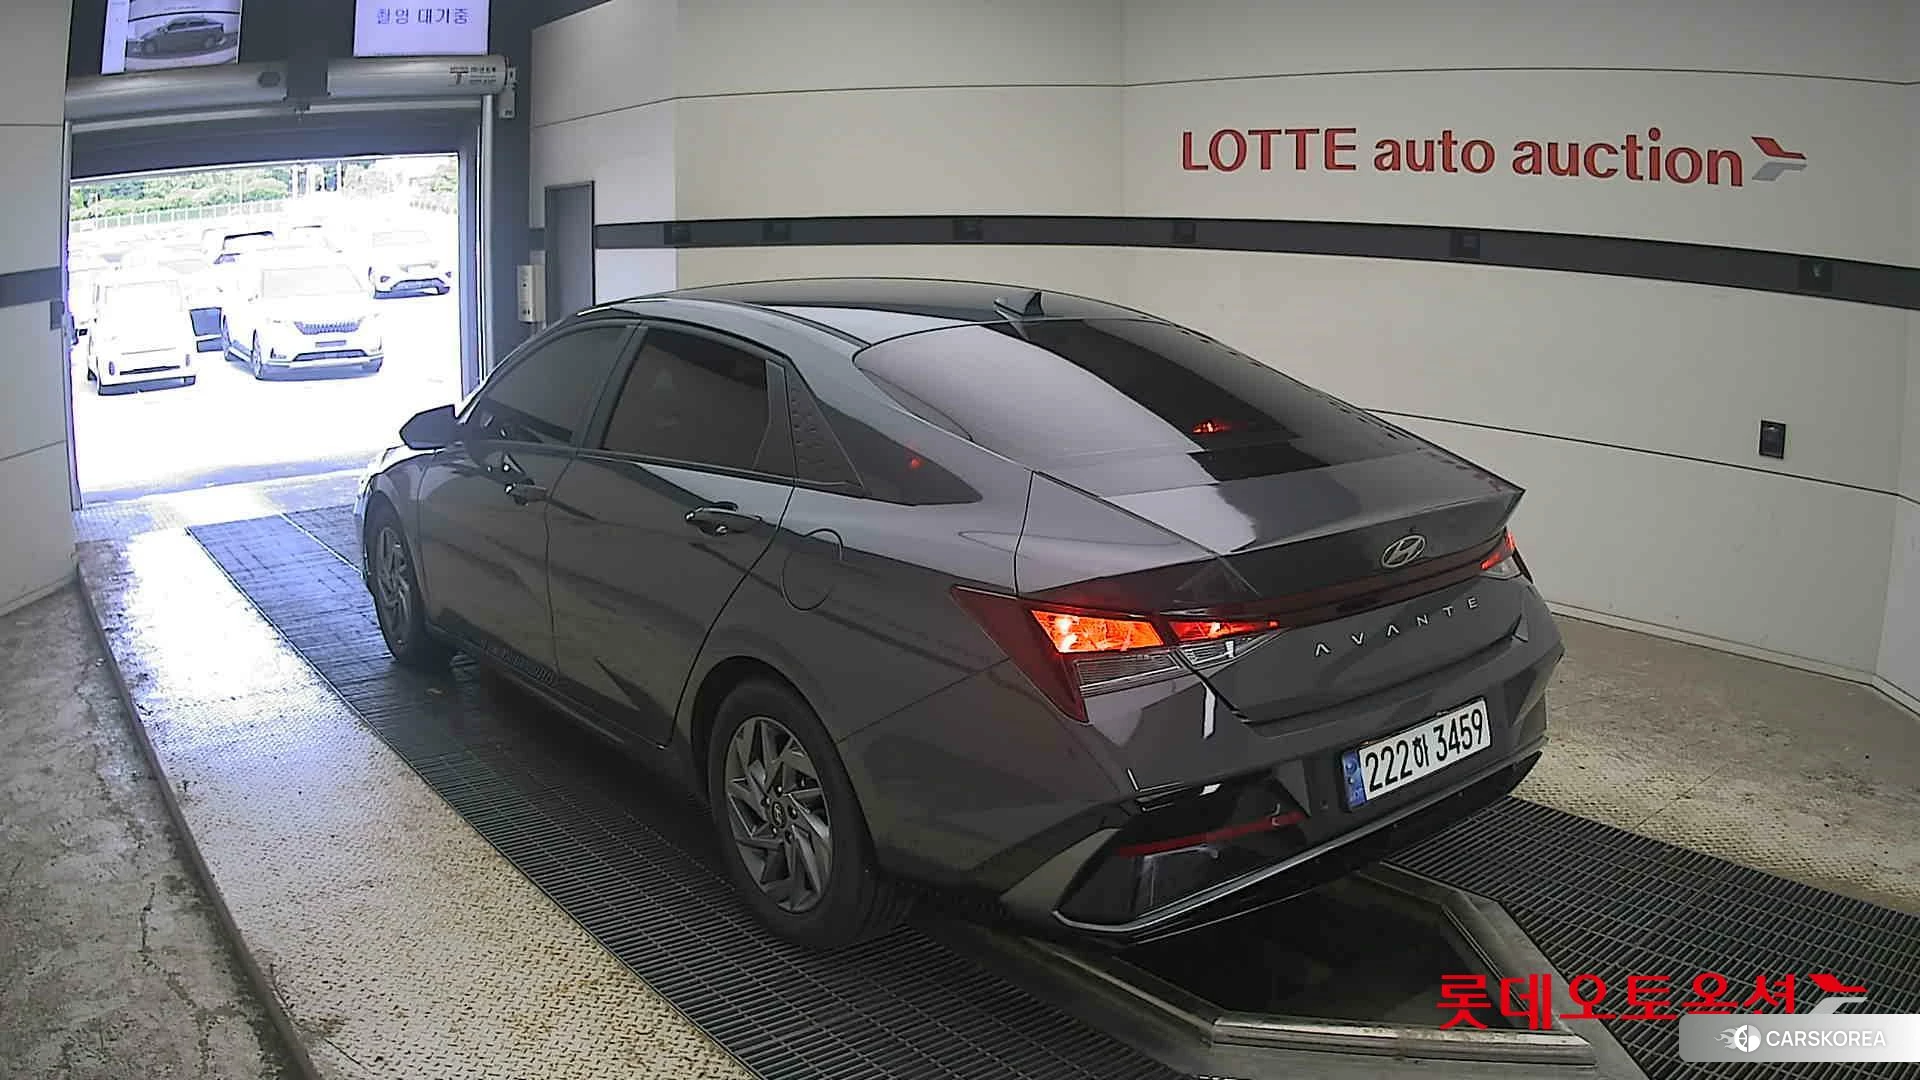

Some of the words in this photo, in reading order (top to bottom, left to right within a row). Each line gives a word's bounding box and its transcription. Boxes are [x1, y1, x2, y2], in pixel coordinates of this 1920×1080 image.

[1182, 127, 1357, 172] LOTTE
[1373, 129, 1496, 174] auto
[1511, 127, 1744, 187] auction
[1314, 597, 1479, 657] AVANTE
[1433, 708, 1484, 762] 3459
